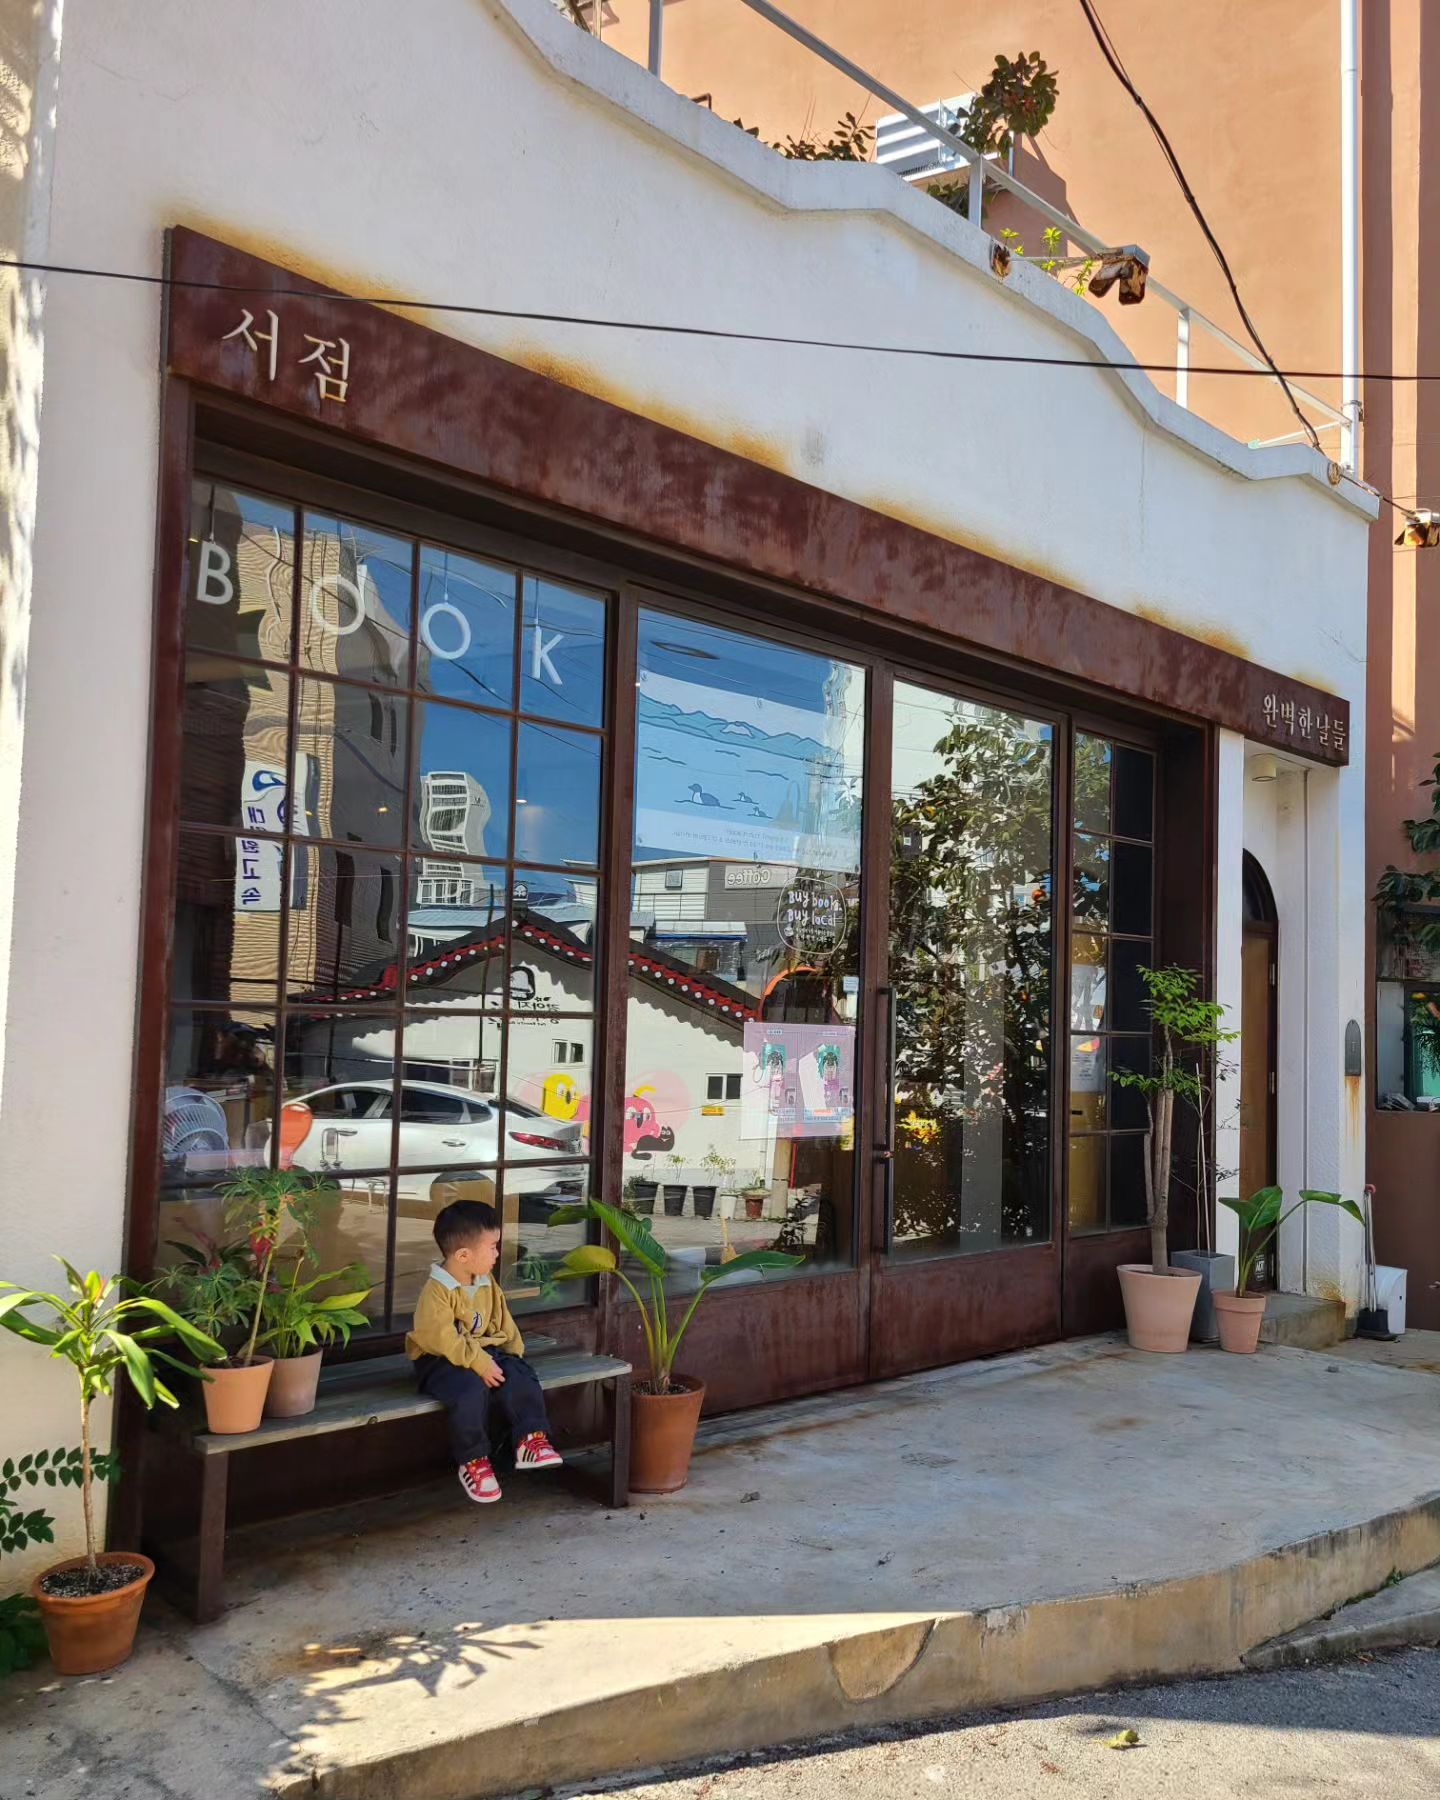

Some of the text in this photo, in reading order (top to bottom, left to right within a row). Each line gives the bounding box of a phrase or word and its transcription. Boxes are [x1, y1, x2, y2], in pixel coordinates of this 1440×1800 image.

[221, 308, 350, 404] 서점
[787, 891, 809, 908] Buy
[787, 909, 836, 926] Buy local
